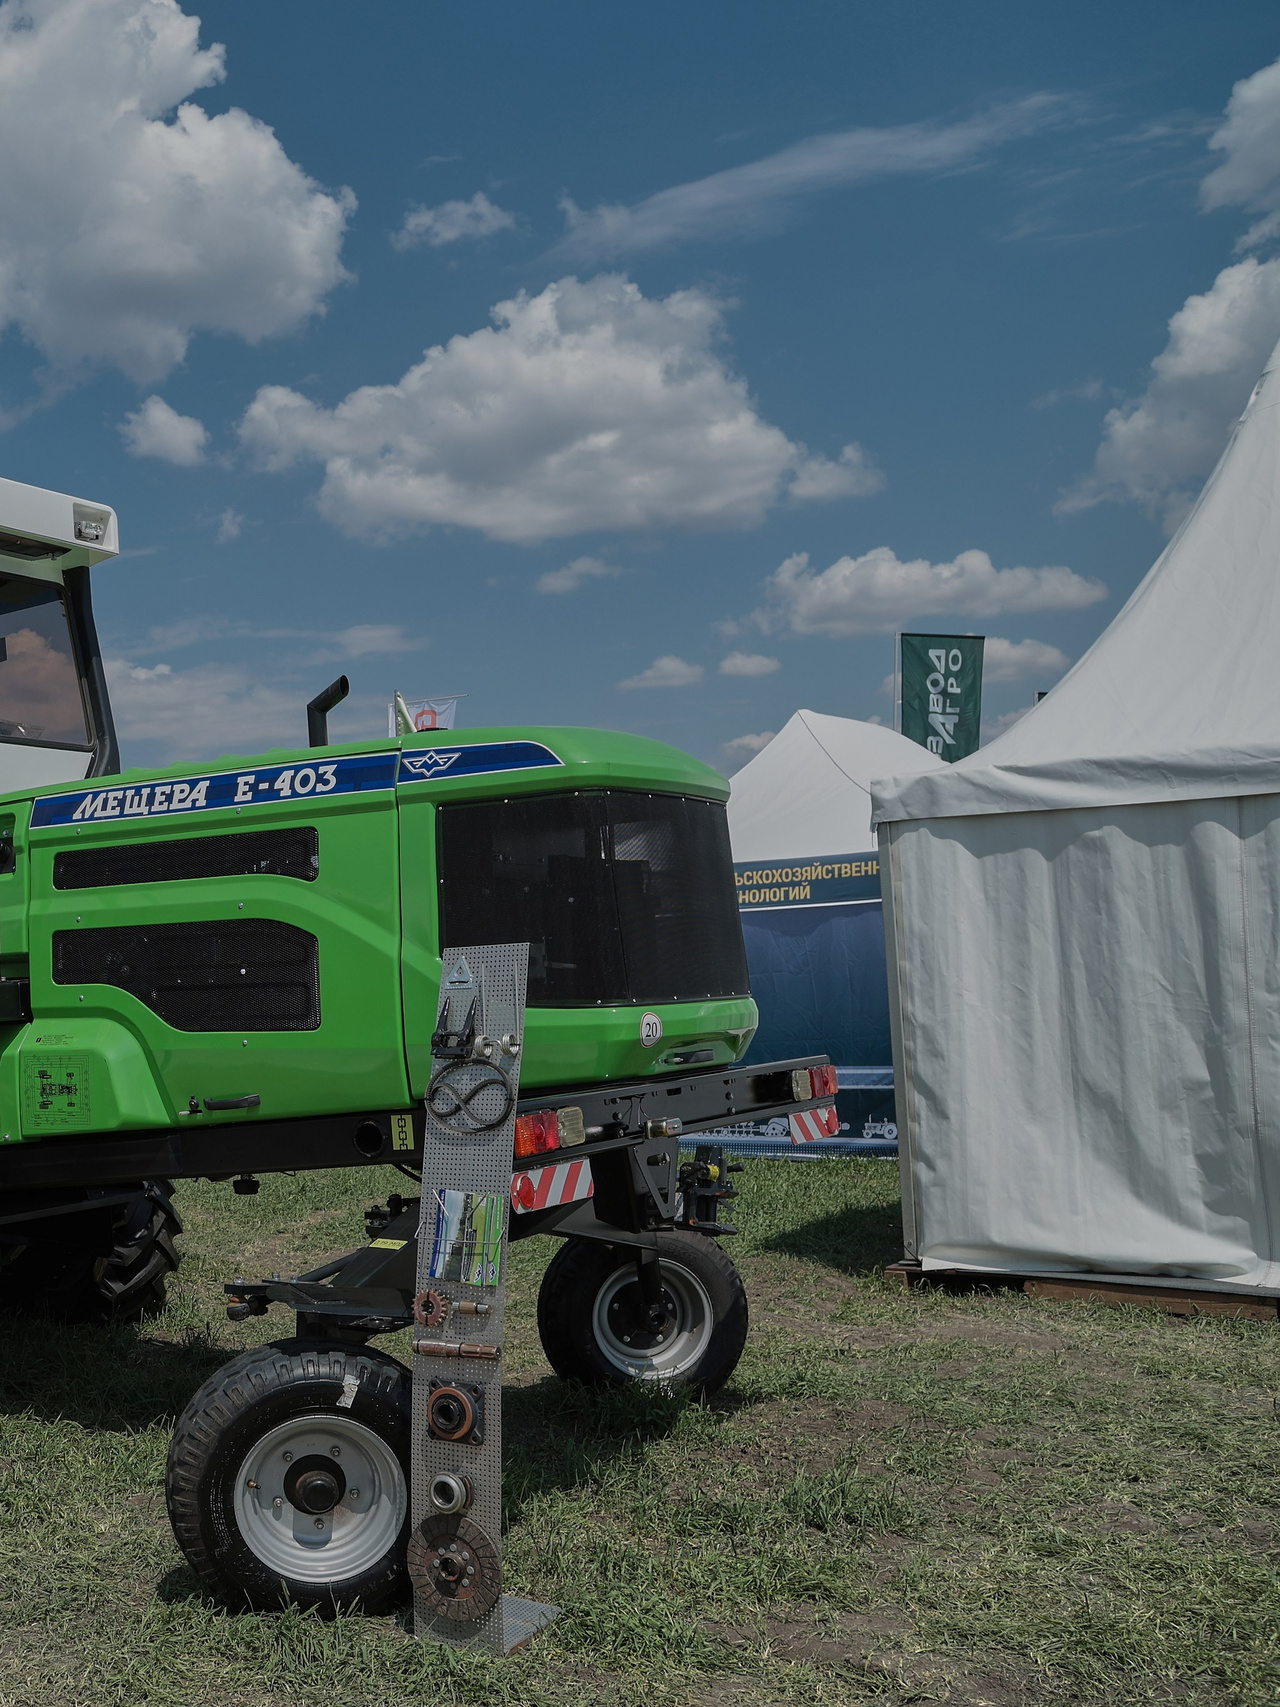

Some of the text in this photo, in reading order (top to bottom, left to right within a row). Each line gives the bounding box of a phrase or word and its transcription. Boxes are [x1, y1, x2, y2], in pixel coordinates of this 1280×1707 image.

[72, 779, 210, 820] МЕЩЕРА
[736, 882, 811, 904] НОЛОГИЙ
[645, 1022, 658, 1038] 20
